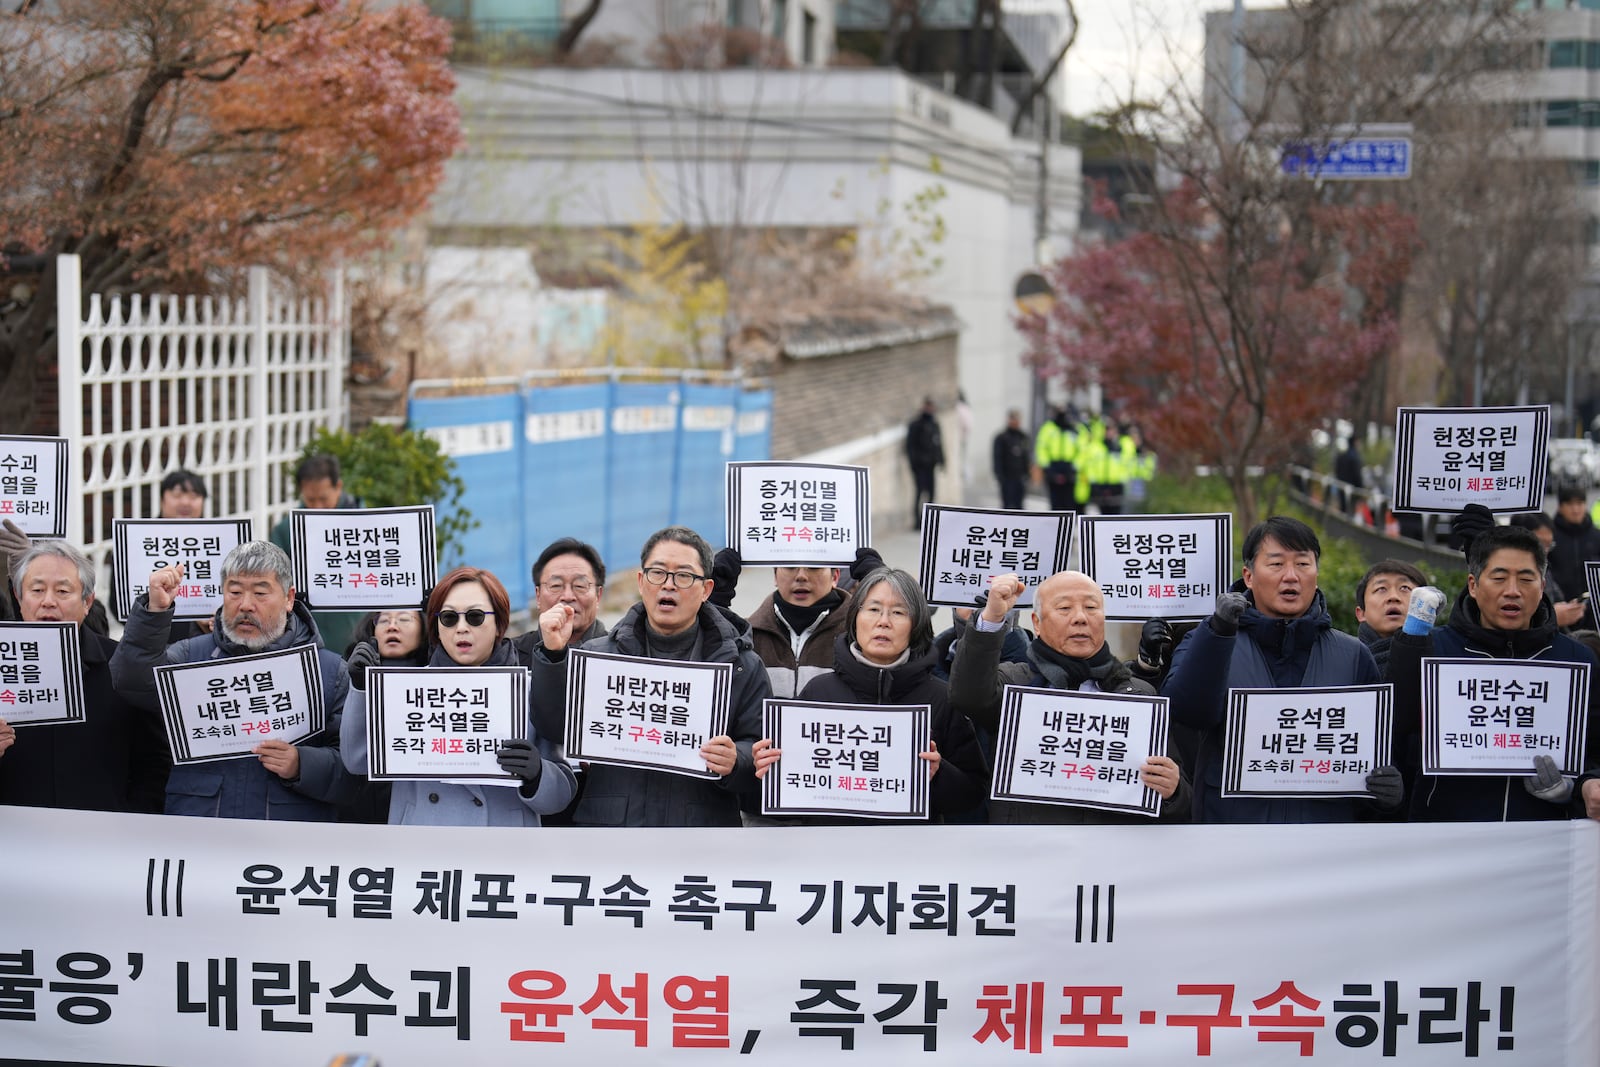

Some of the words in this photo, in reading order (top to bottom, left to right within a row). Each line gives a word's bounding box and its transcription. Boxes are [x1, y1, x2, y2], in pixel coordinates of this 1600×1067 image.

[1433, 425, 1518, 448] 헌정유린
[1442, 450, 1506, 472] 윤석열
[760, 480, 837, 500] 증거인멸
[1417, 476, 1461, 492] 국민이
[1466, 475, 1526, 492] 체포한다!
[760, 502, 838, 522] 윤석열을
[324, 526, 400, 547] 내란자백
[746, 526, 777, 542] 즉각
[782, 526, 851, 543] 구속하라!
[966, 526, 1030, 548] 윤석열
[1112, 533, 1197, 555] 헌정유린
[142, 536, 222, 557] 헌정유린
[325, 548, 401, 569] 윤석열을
[952, 548, 993, 569] 내란
[999, 551, 1040, 571] 특검
[1123, 557, 1186, 579] 윤석열
[313, 573, 343, 588] 즉각
[348, 572, 416, 588] 구속하라!
[939, 571, 982, 587] 조속히
[1101, 583, 1143, 599] 국민이
[1147, 583, 1211, 598] 체포한다!
[206, 671, 275, 698] 윤석열
[607, 675, 691, 703] 내란자백
[1458, 679, 1549, 703] 내란수괴
[197, 699, 241, 721] 내란
[248, 691, 293, 715] 특검
[406, 687, 489, 709] 내란수괴
[405, 712, 490, 733] 윤석열을
[604, 698, 690, 727] 윤석열을
[1277, 707, 1346, 729] 윤석열
[1468, 705, 1535, 728] 윤석열
[192, 724, 237, 740] 조속히
[241, 712, 305, 735] 구성하라!
[589, 721, 624, 740] 즉각
[628, 725, 703, 749] 구속하라!
[801, 722, 892, 747] 내란수괴
[1042, 711, 1130, 738] 내란자백
[391, 738, 426, 754] 즉각
[1038, 734, 1128, 762] 윤석열을
[1261, 733, 1307, 755] 내란
[1314, 732, 1359, 755] 특검
[1444, 733, 1488, 749] 국민이
[1493, 733, 1560, 750] 체포한다!
[811, 747, 880, 772] 윤석열
[1247, 759, 1294, 774] 조속히
[1299, 759, 1369, 774] 구성하라!
[786, 773, 832, 789] 국민이
[837, 775, 905, 793] 체포한다!
[1020, 759, 1056, 778] 즉각
[1060, 762, 1139, 785] 구속하라!
[236, 863, 395, 919] 윤석열
[667, 875, 777, 930] 촉구
[797, 880, 1017, 936] 기자회견
[175, 955, 471, 1040] 내란수괴
[500, 968, 761, 1054] 윤석열,
[790, 979, 948, 1052] 즉각
